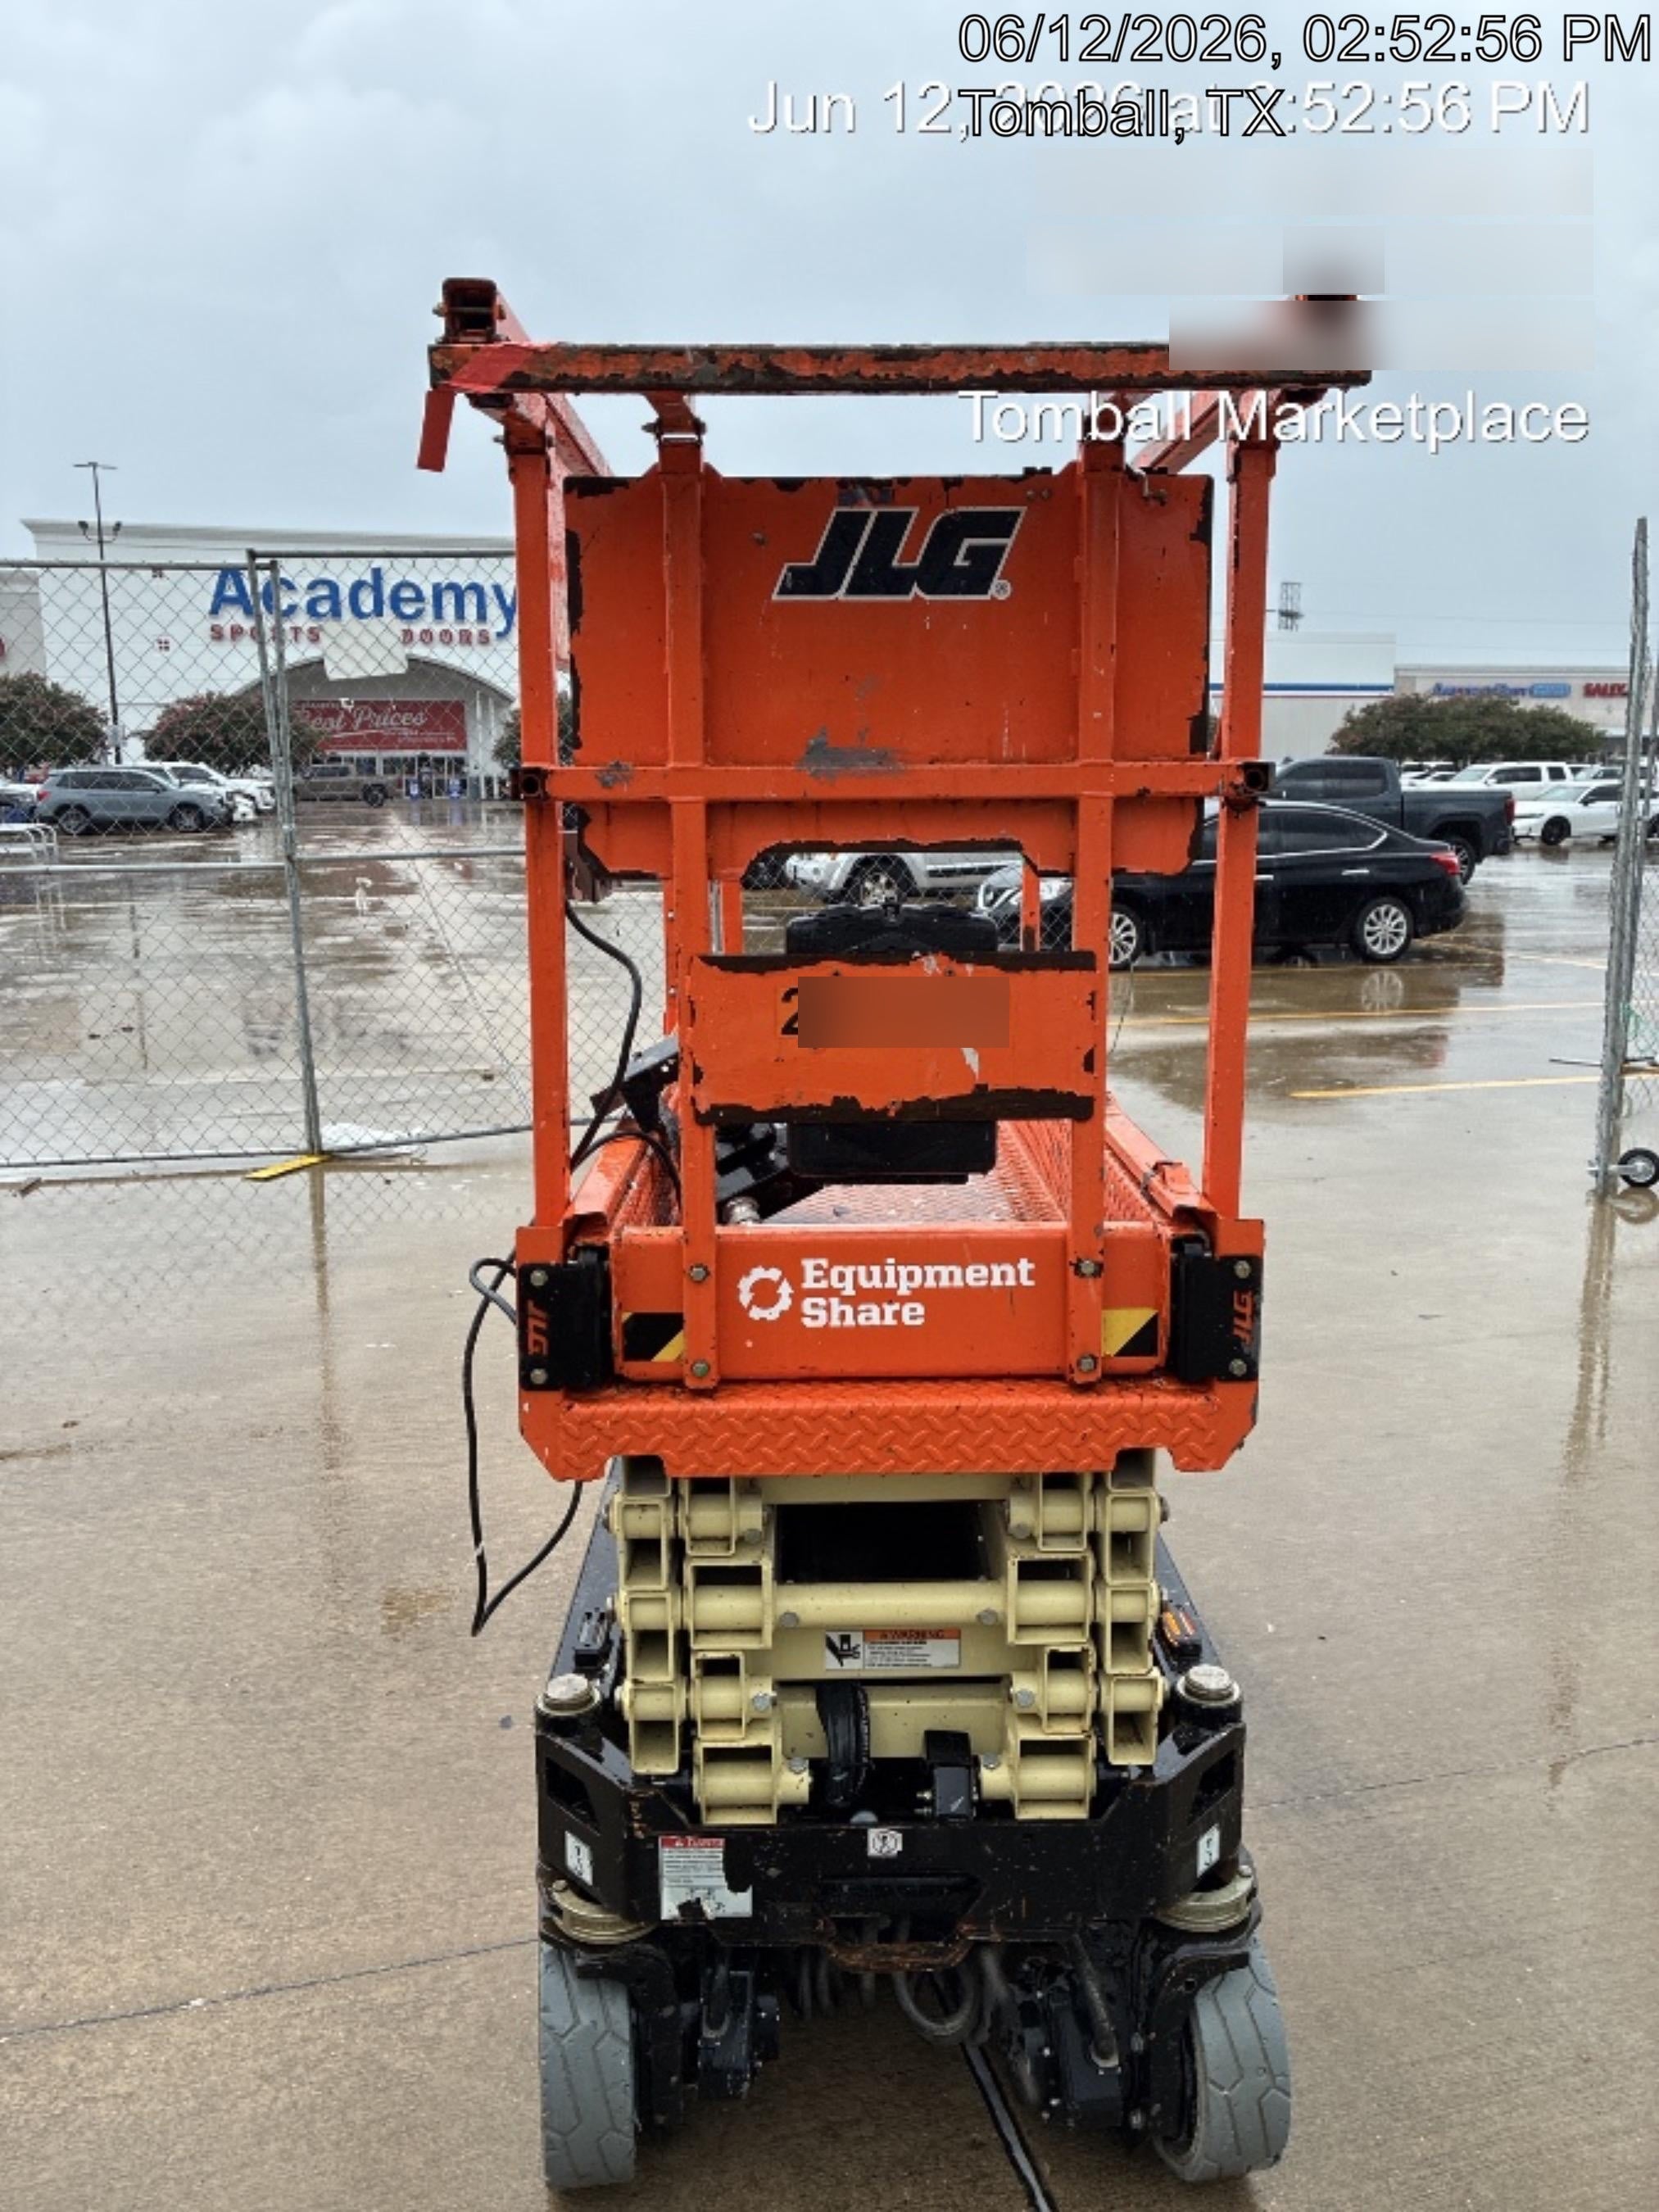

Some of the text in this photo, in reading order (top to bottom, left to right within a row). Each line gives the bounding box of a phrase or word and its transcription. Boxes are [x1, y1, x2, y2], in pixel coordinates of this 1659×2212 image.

[772, 505, 1027, 601] JLG
[208, 567, 516, 638] Academy
[800, 1258, 1036, 1296] Equipment
[800, 1297, 926, 1328] Share
